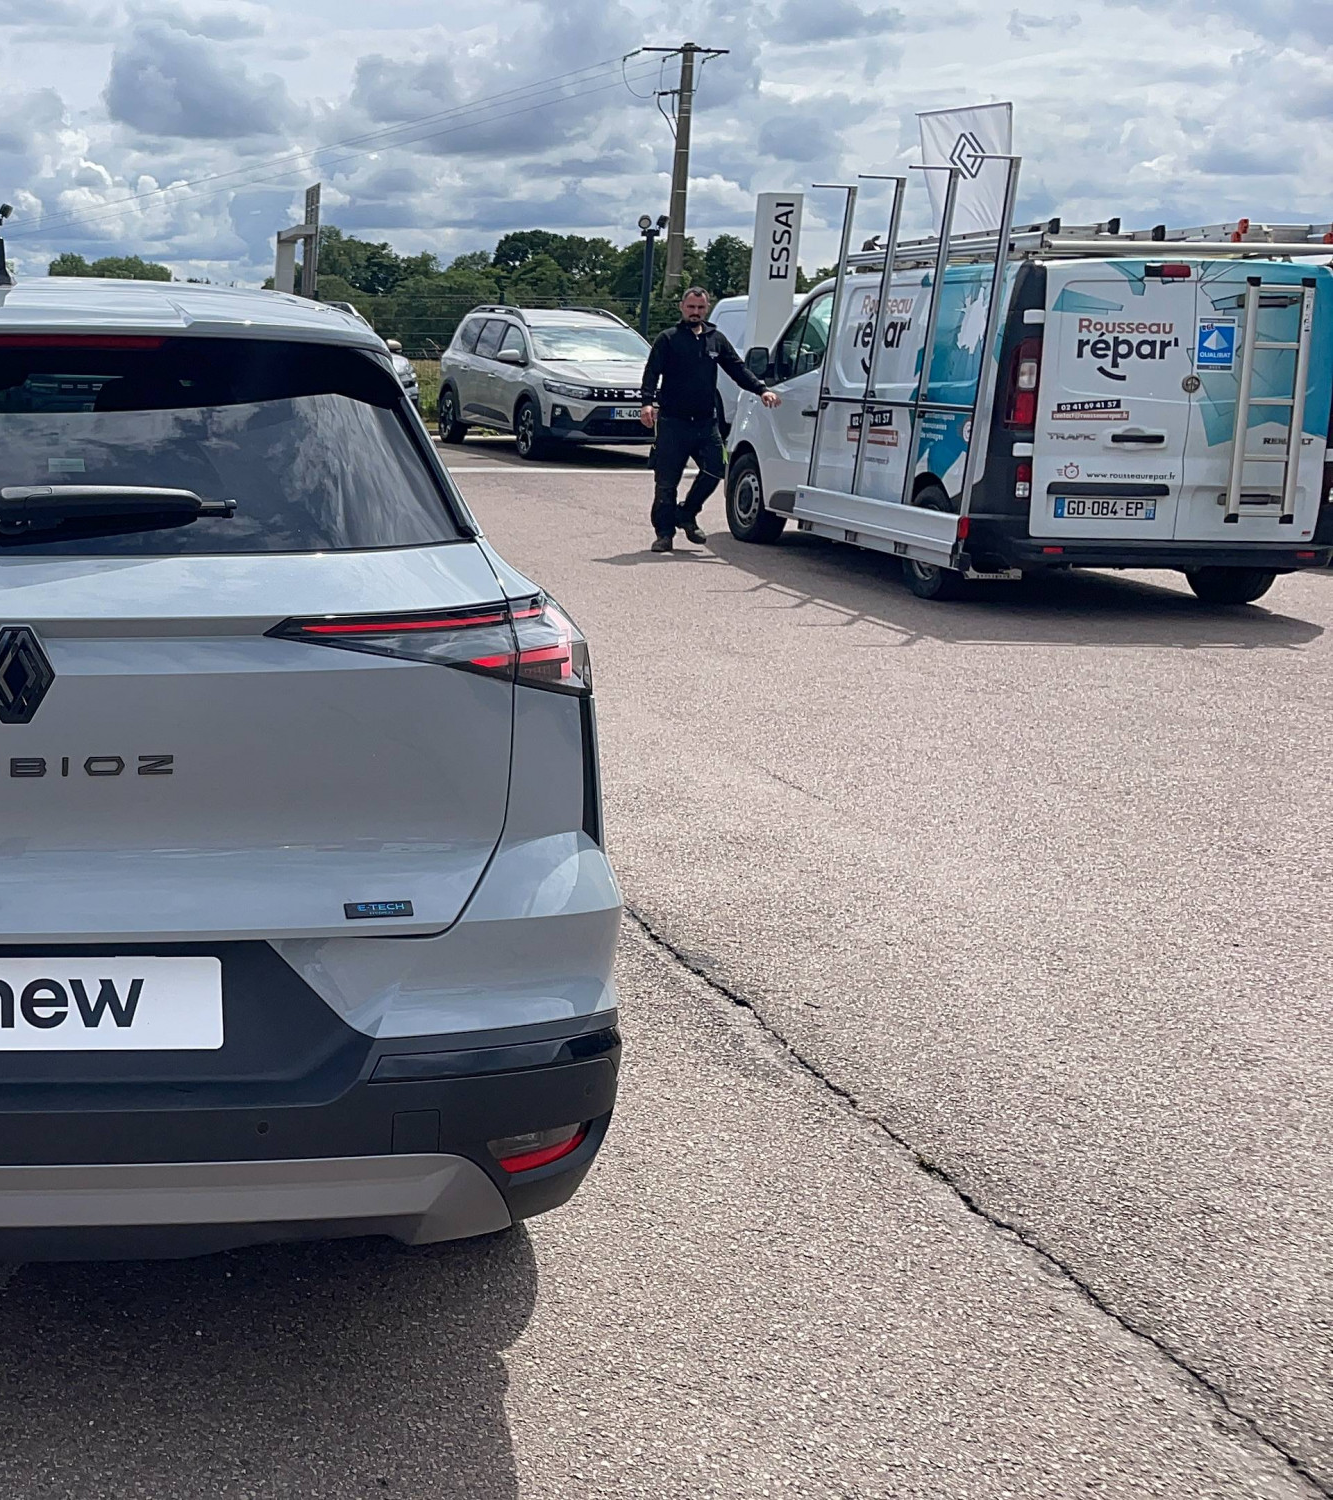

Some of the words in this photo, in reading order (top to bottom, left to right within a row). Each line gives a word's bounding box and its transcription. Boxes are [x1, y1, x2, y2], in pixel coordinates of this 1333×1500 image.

[769, 202, 794, 280] ESSAI
[1078, 317, 1174, 335] Rousseau
[1084, 402, 1094, 410] 69
[1107, 400, 1117, 408] 57
[1047, 432, 1097, 441] TRAFIC
[1086, 471, 1176, 482] www.rousseaurepar.fr
[357, 903, 405, 912] E-TECH
